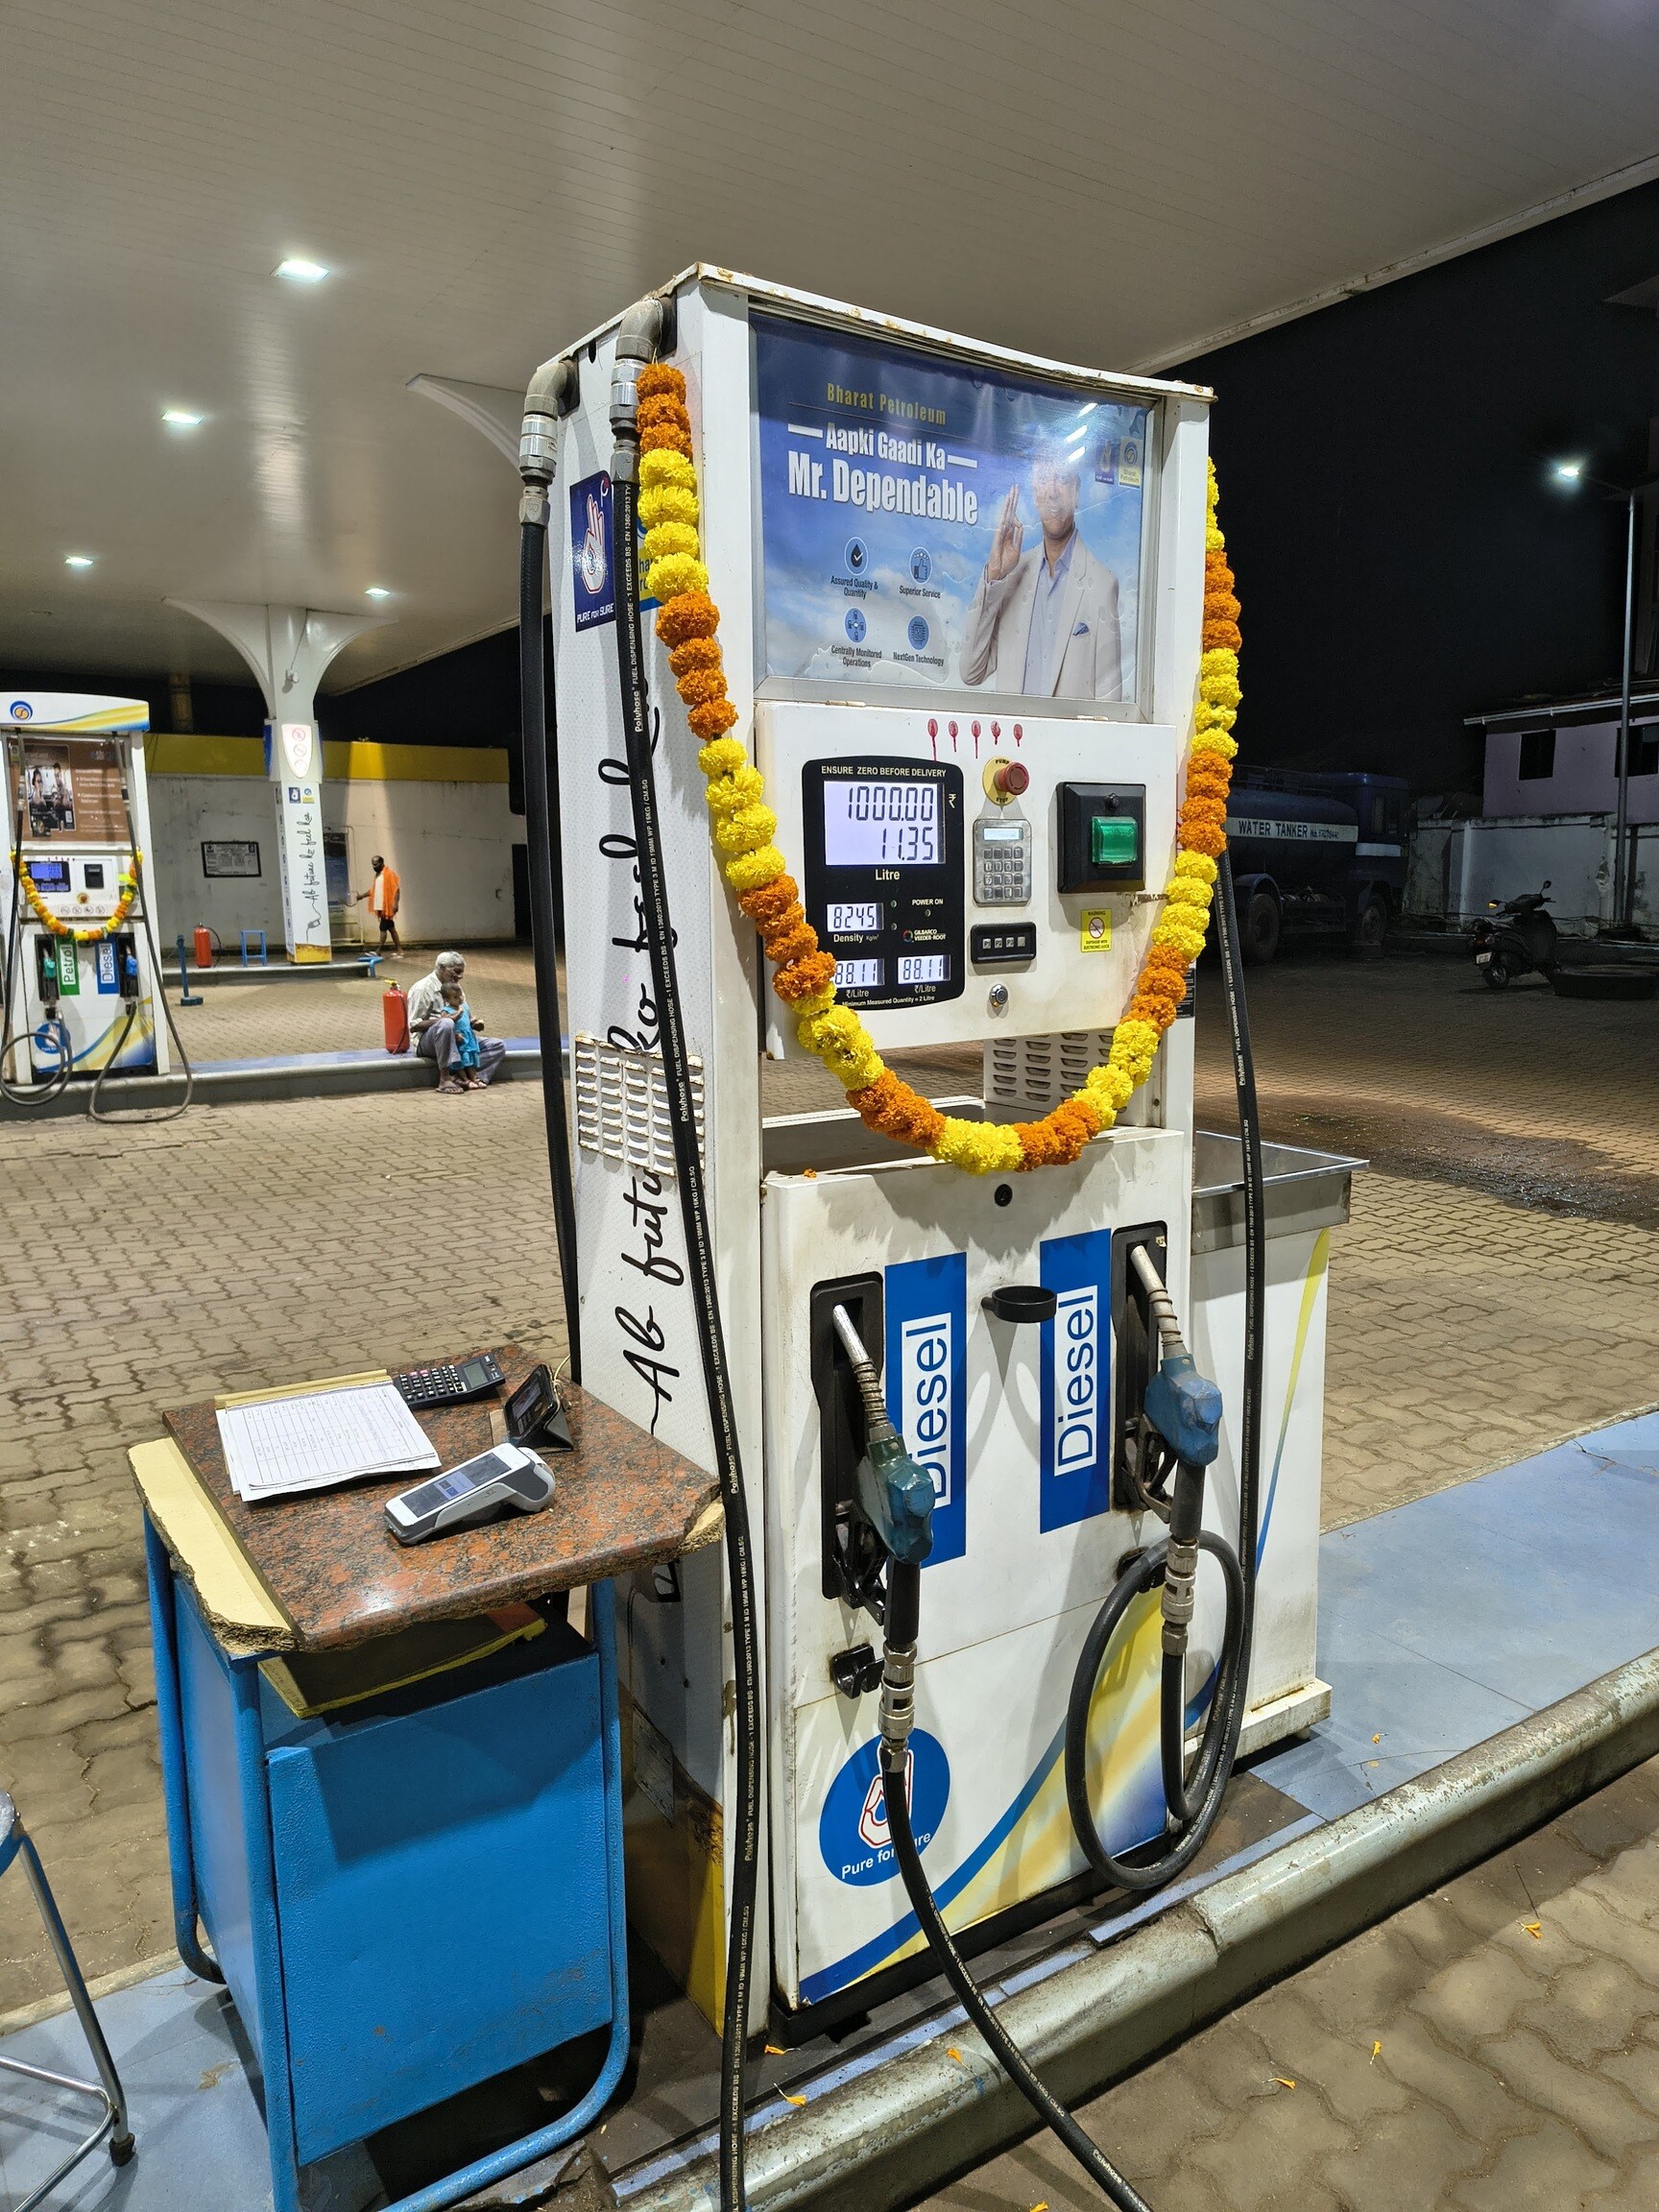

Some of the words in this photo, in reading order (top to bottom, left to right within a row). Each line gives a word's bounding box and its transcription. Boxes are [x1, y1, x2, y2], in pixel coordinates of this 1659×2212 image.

[827, 382, 875, 411] Bharat
[879, 394, 947, 425] Petroleum
[826, 422, 875, 457] Aapki
[878, 431, 923, 467] Gaadi
[926, 442, 947, 470] Ka
[788, 450, 827, 500] Mr.
[832, 458, 978, 526] Dependable
[624, 530, 631, 541] EN
[624, 545, 631, 557] BS
[830, 575, 854, 588] Assured
[854, 578, 872, 591] Quality
[843, 587, 867, 600] Quantity
[899, 586, 921, 598] Superior
[922, 589, 941, 599] Service
[577, 611, 590, 623] PURE
[600, 603, 614, 615] SURE
[626, 601, 635, 622] HOSE
[628, 623, 637, 665] DISPENSING
[830, 644, 855, 659] Centrally
[855, 649, 882, 660] Monitored
[842, 657, 872, 668] Operations
[893, 651, 915, 664] NextGen
[915, 654, 945, 667] Technology
[632, 689, 643, 733] Polyhose
[821, 766, 854, 776] ENSURE
[856, 767, 878, 776] ZERO
[879, 768, 910, 777] BEFORE
[911, 769, 947, 778] DELIVERY
[640, 779, 650, 802] CM.SQ
[848, 785, 934, 822] 1000.00
[646, 825, 653, 837] WP
[1238, 820, 1271, 836] WATER
[1276, 822, 1309, 838] TANKER
[647, 837, 656, 856] 19MM
[881, 827, 934, 861] 11.35
[875, 869, 901, 880] Litre
[833, 906, 875, 928] 8245
[659, 930, 665, 940] EN
[833, 934, 864, 943] Density
[660, 945, 667, 955] BS
[63, 945, 74, 983] Petrol
[102, 943, 113, 982] Diesel
[661, 955, 671, 988] EXCEEDS
[903, 958, 943, 980] 88.11
[834, 963, 876, 985] 88.11
[666, 998, 675, 1018] HOSE
[893, 996, 915, 1004] Quantity
[668, 1018, 681, 1058] DISPENSING
[676, 1080, 689, 1122] Polyhose
[687, 1166, 697, 1189] CM.SQ
[693, 1209, 701, 1221] WP
[621, 1166, 684, 1287] futu
[700, 1261, 709, 1278] TYPE
[707, 1310, 714, 1320] EN
[615, 1307, 680, 1404] Ab
[709, 1334, 720, 1365] EXCEEDS
[715, 1374, 724, 1394] HOSE
[1058, 1292, 1094, 1467] Diesel
[719, 1393, 730, 1433] DISPENSING
[724, 1432, 733, 1451] FUEL
[726, 1454, 739, 1494] Polyhose
[841, 1857, 874, 1879] Pure
[878, 1847, 894, 1863] for
[915, 1833, 930, 1849] ure
